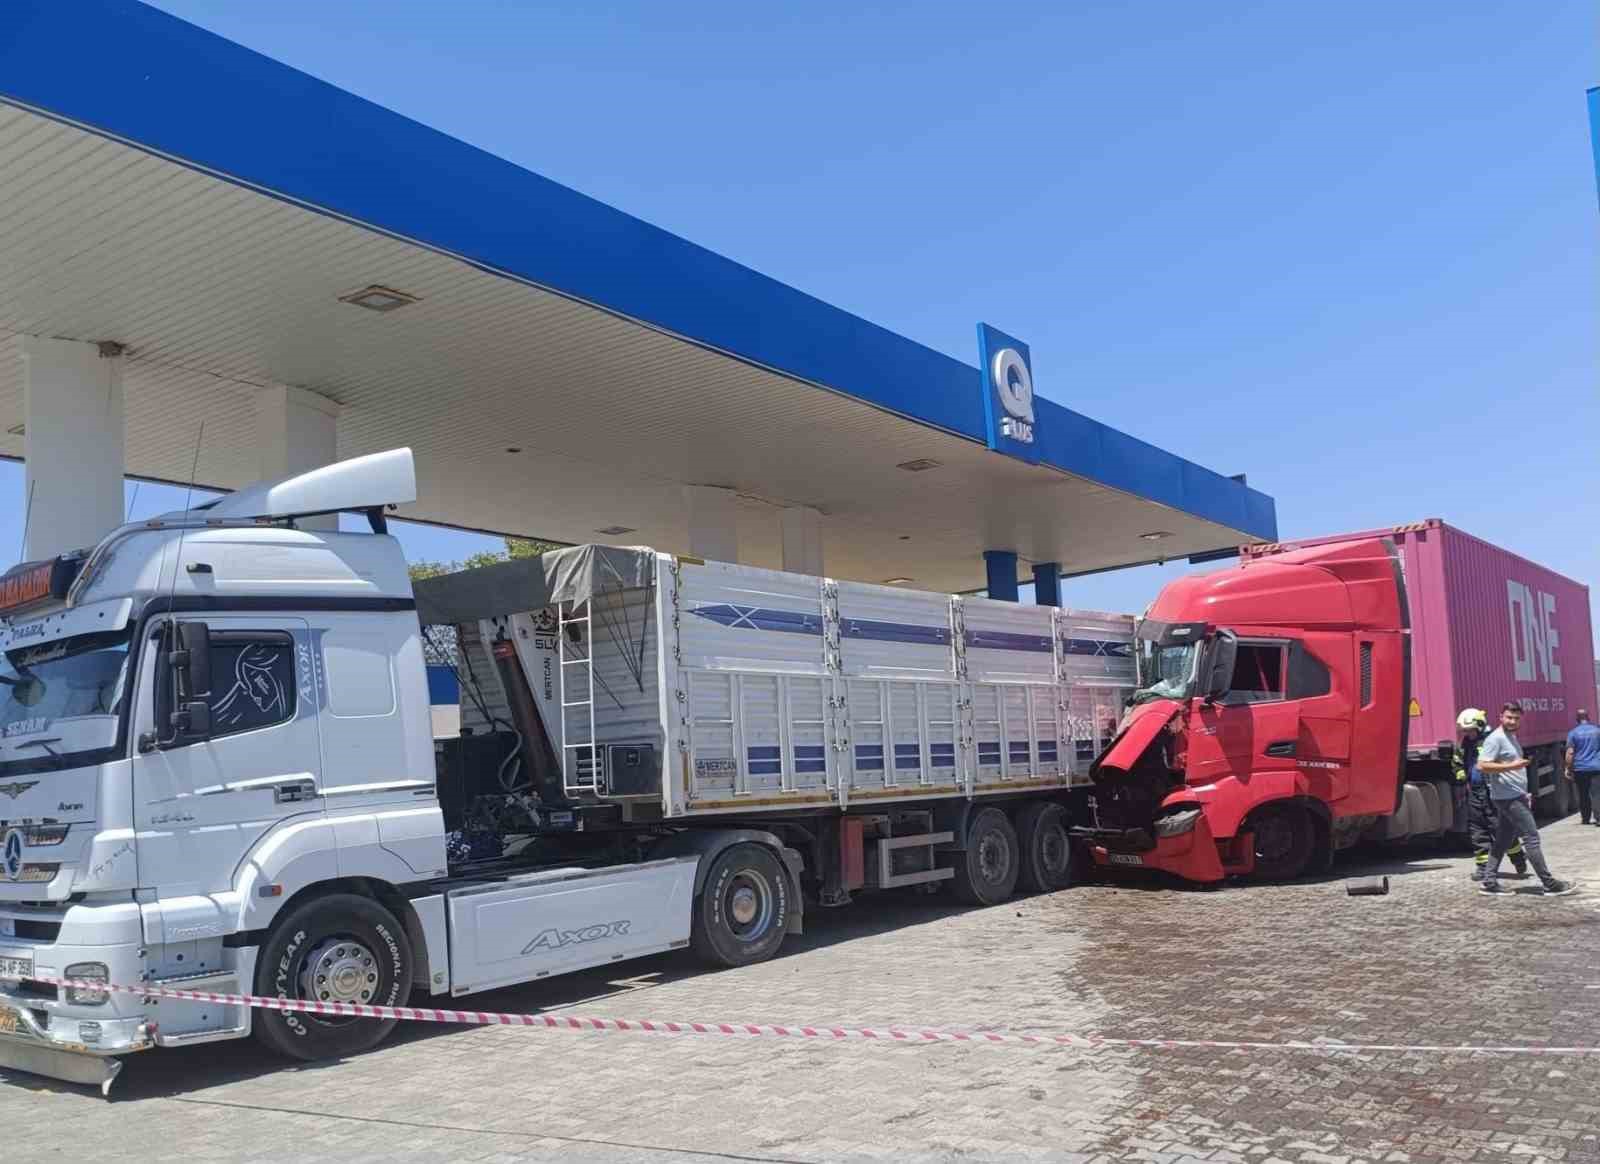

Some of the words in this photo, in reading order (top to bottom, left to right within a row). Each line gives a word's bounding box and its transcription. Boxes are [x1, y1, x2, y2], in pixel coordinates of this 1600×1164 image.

[992, 347, 1035, 423] Q
[1507, 580, 1562, 683] ONE
[376, 923, 401, 977] REGIONAL
